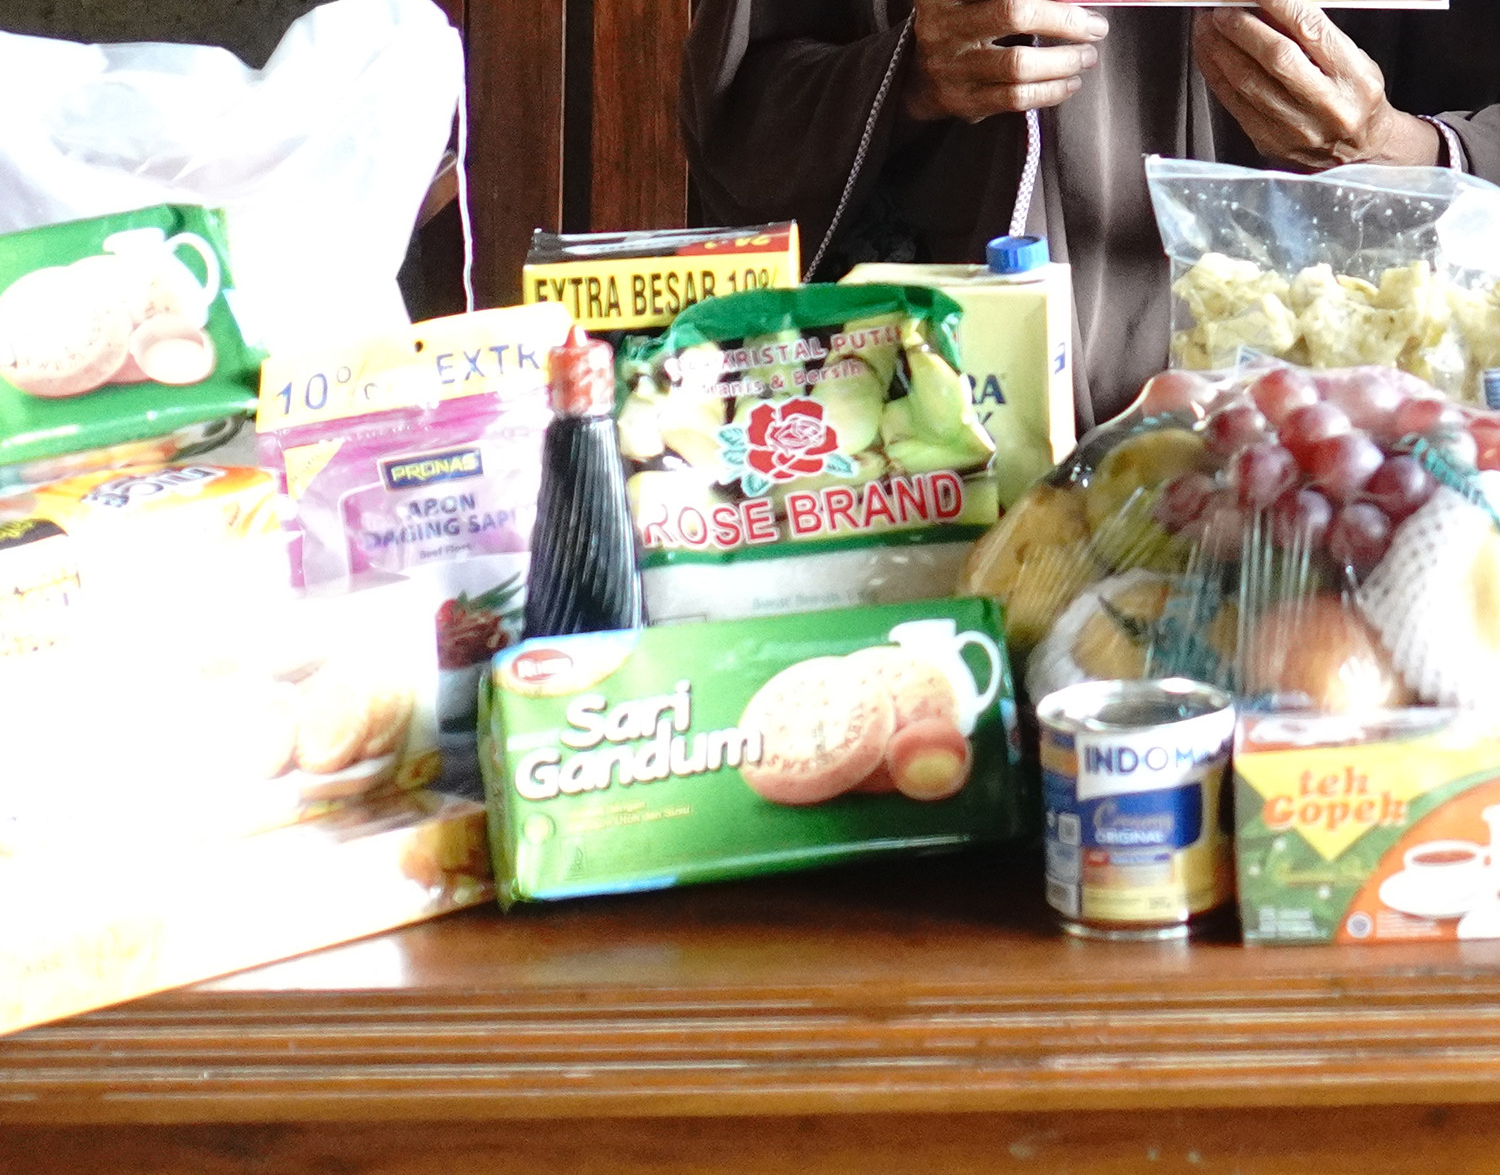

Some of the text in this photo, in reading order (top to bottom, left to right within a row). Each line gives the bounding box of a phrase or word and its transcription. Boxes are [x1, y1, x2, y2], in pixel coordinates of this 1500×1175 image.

[436, 343, 540, 384] EXTR
[723, 338, 829, 372] KRISTAL
[391, 453, 478, 481] PRONAS
[642, 472, 962, 546] ROSE BRAND
[560, 679, 691, 750] Sari
[514, 718, 763, 802] Gandum
[1085, 744, 1212, 774] INDOM
[1299, 765, 1368, 796] teh
